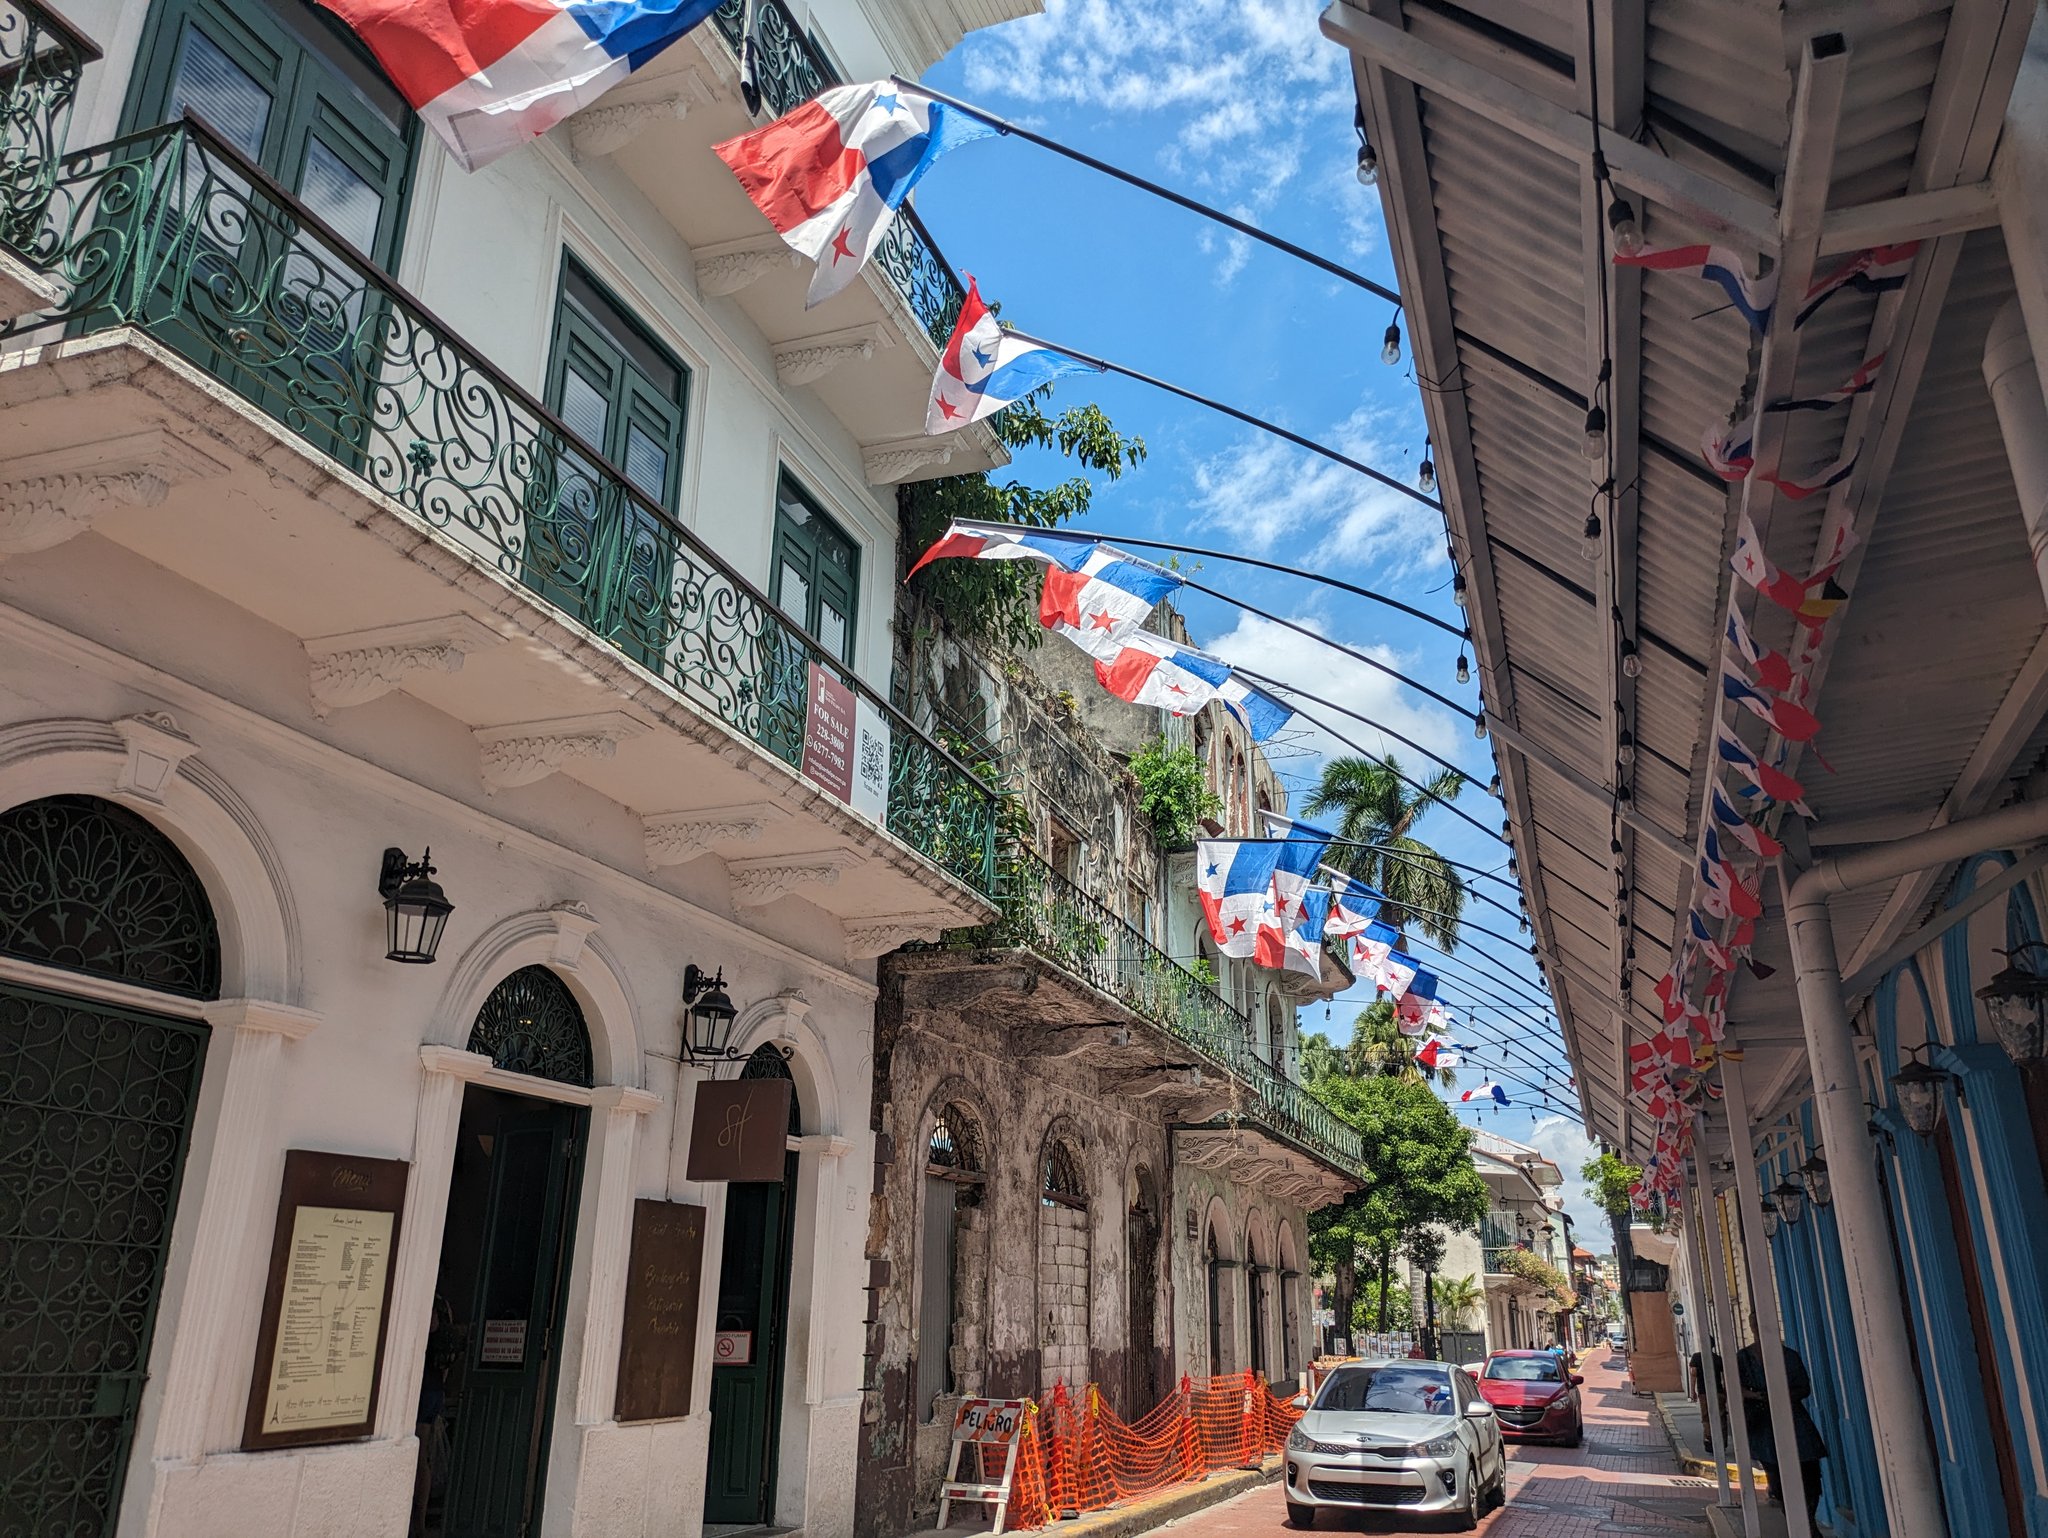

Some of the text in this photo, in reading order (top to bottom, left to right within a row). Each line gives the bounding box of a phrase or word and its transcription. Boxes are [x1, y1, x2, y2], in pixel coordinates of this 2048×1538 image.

[814, 703, 850, 740] FOR SALE
[813, 740, 846, 772] 6277-7982
[961, 1409, 1012, 1433] PELIGRO
